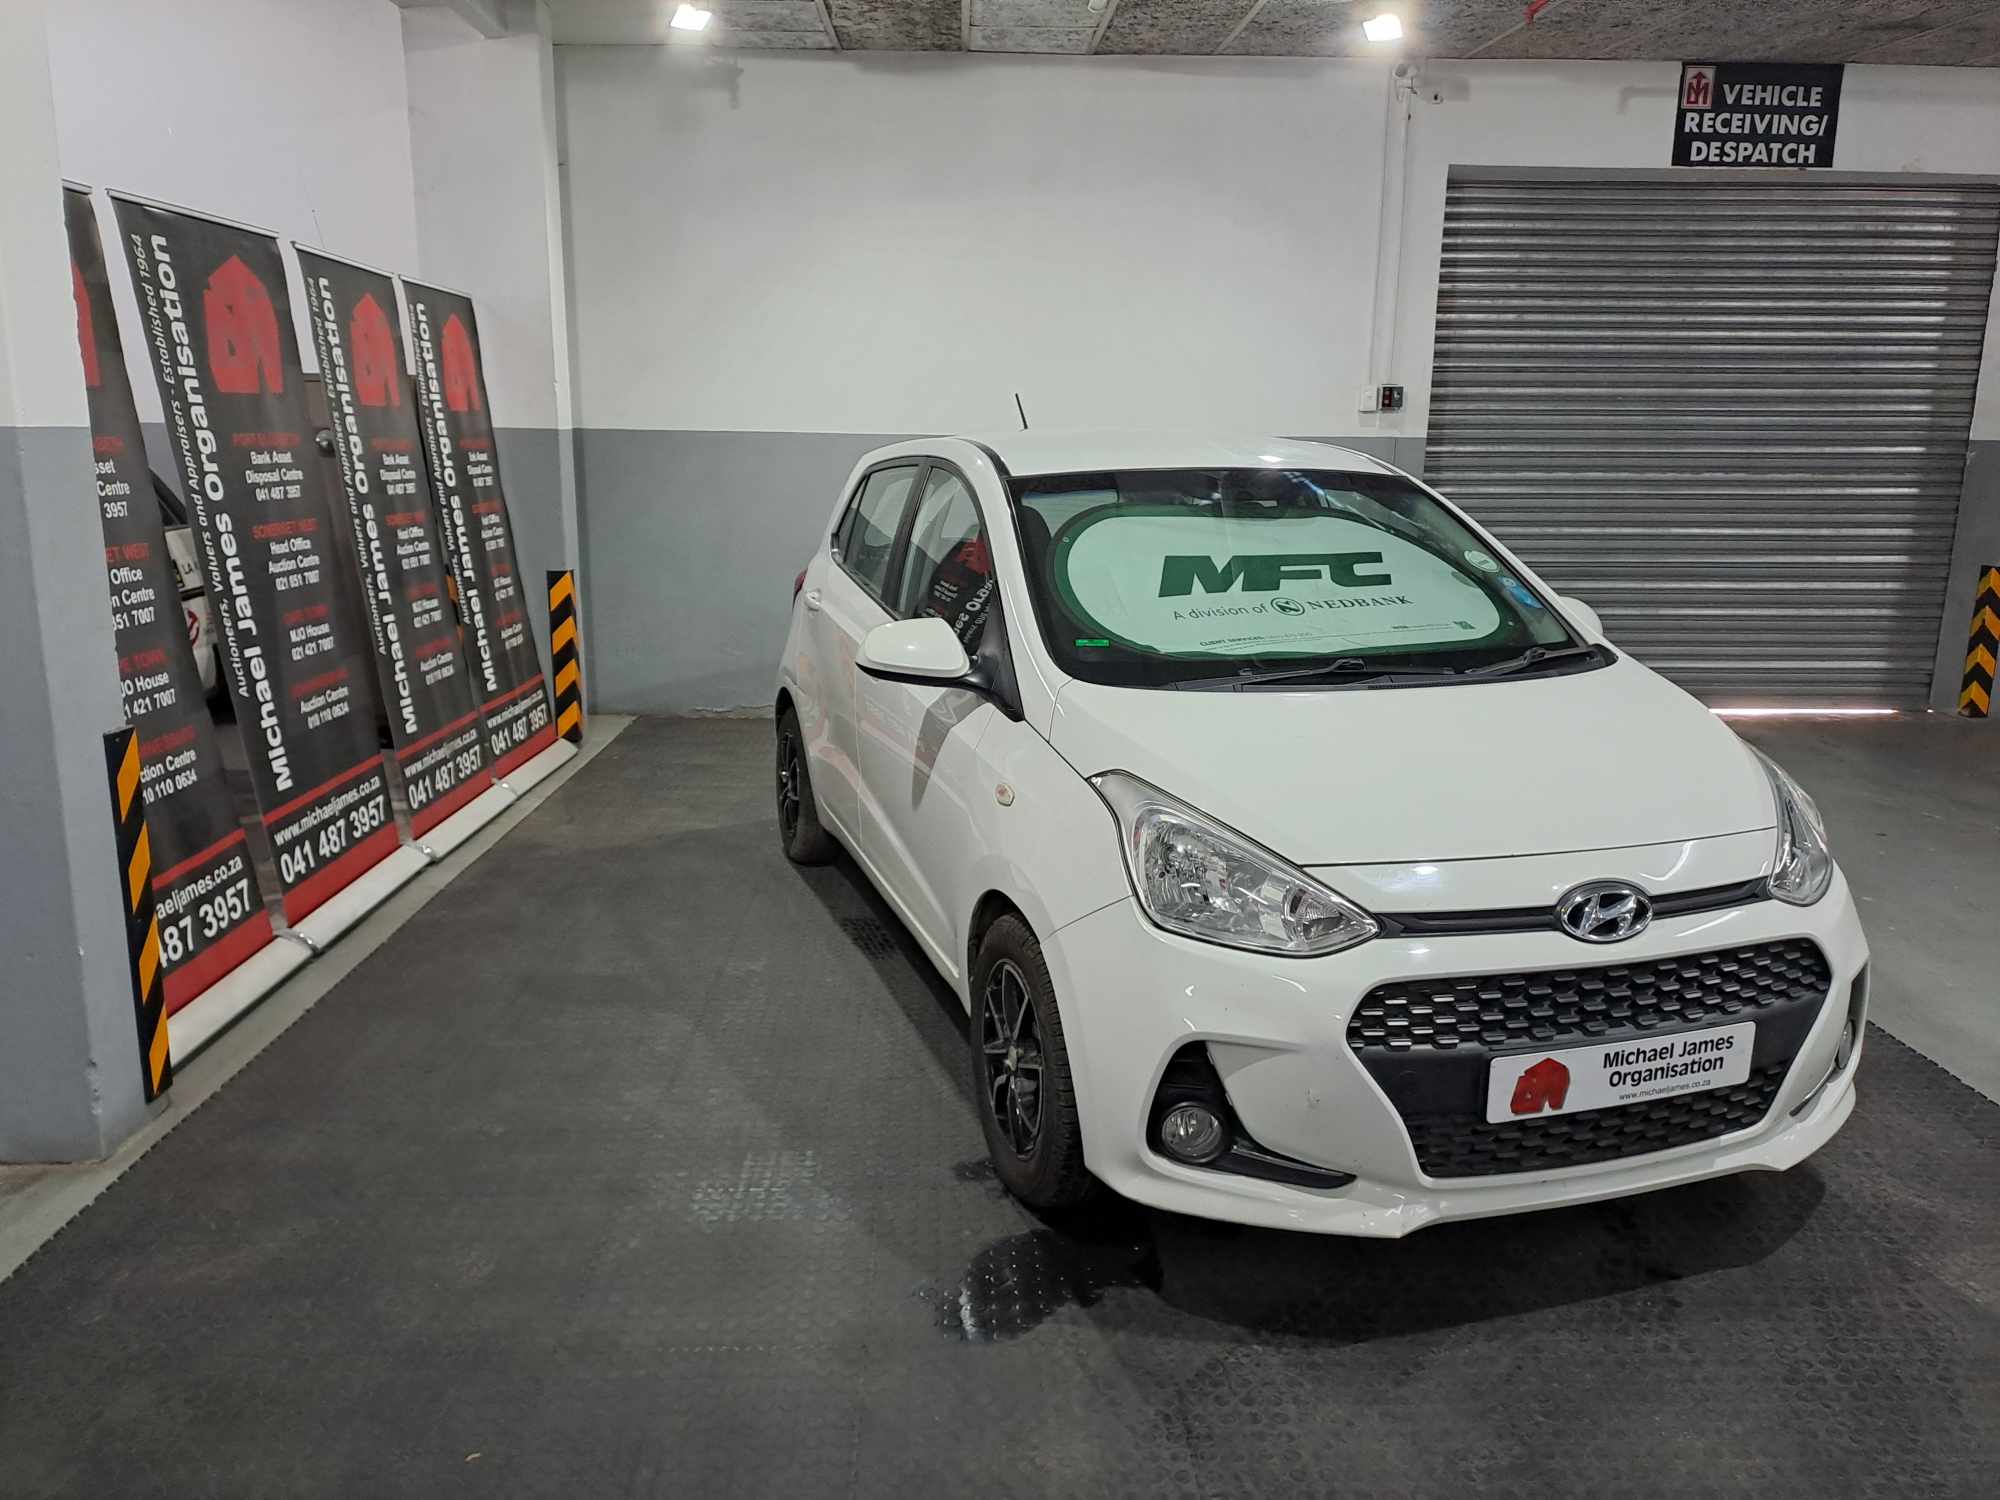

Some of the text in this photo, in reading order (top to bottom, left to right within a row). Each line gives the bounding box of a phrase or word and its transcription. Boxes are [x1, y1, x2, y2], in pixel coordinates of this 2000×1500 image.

[1722, 84, 1824, 107] VEHICLE
[1684, 112, 1828, 136] RECEIVING/
[1690, 141, 1816, 164] DESPATCH
[131, 233, 151, 279] 1964
[141, 282, 175, 385] Established
[416, 303, 456, 487] Organisation
[171, 400, 200, 490] Appraisers
[333, 411, 352, 485] Appraisers
[97, 480, 130, 497] Centre
[319, 277, 418, 734] Michael James Organisation
[346, 486, 359, 515] and
[104, 501, 128, 519] 3957
[151, 234, 294, 792] Michael James Organisation
[190, 494, 208, 526] and
[354, 518, 369, 569] Valuers
[450, 495, 476, 582] James
[110, 567, 143, 585] Office
[202, 531, 224, 592] Valuers
[1158, 552, 1392, 597] MFC
[121, 587, 155, 606] Centre
[131, 606, 155, 626] 7007
[1173, 609, 1185, 620] A
[1188, 603, 1250, 620] division
[1252, 602, 1272, 614] of
[1308, 594, 1416, 610] NEDBANK
[219, 598, 249, 698] Auctioneers,
[466, 588, 498, 692] Michael
[133, 695, 153, 715] 421
[153, 687, 176, 709] 7007
[135, 671, 169, 691] House
[491, 702, 548, 756] 041 487 3957
[166, 748, 196, 772] Centre
[408, 744, 482, 809] 041 487 3957
[155, 778, 174, 799] 110
[175, 767, 198, 788] 0634
[274, 775, 381, 846] www.michaeljames.co.za
[280, 795, 384, 884] 041 487 3957
[199, 877, 251, 938] 3957
[1602, 1034, 1734, 1069] Michael James
[1608, 1055, 1724, 1087] Organisation
[1618, 1078, 1711, 1100] www.michaeljames.co.za
